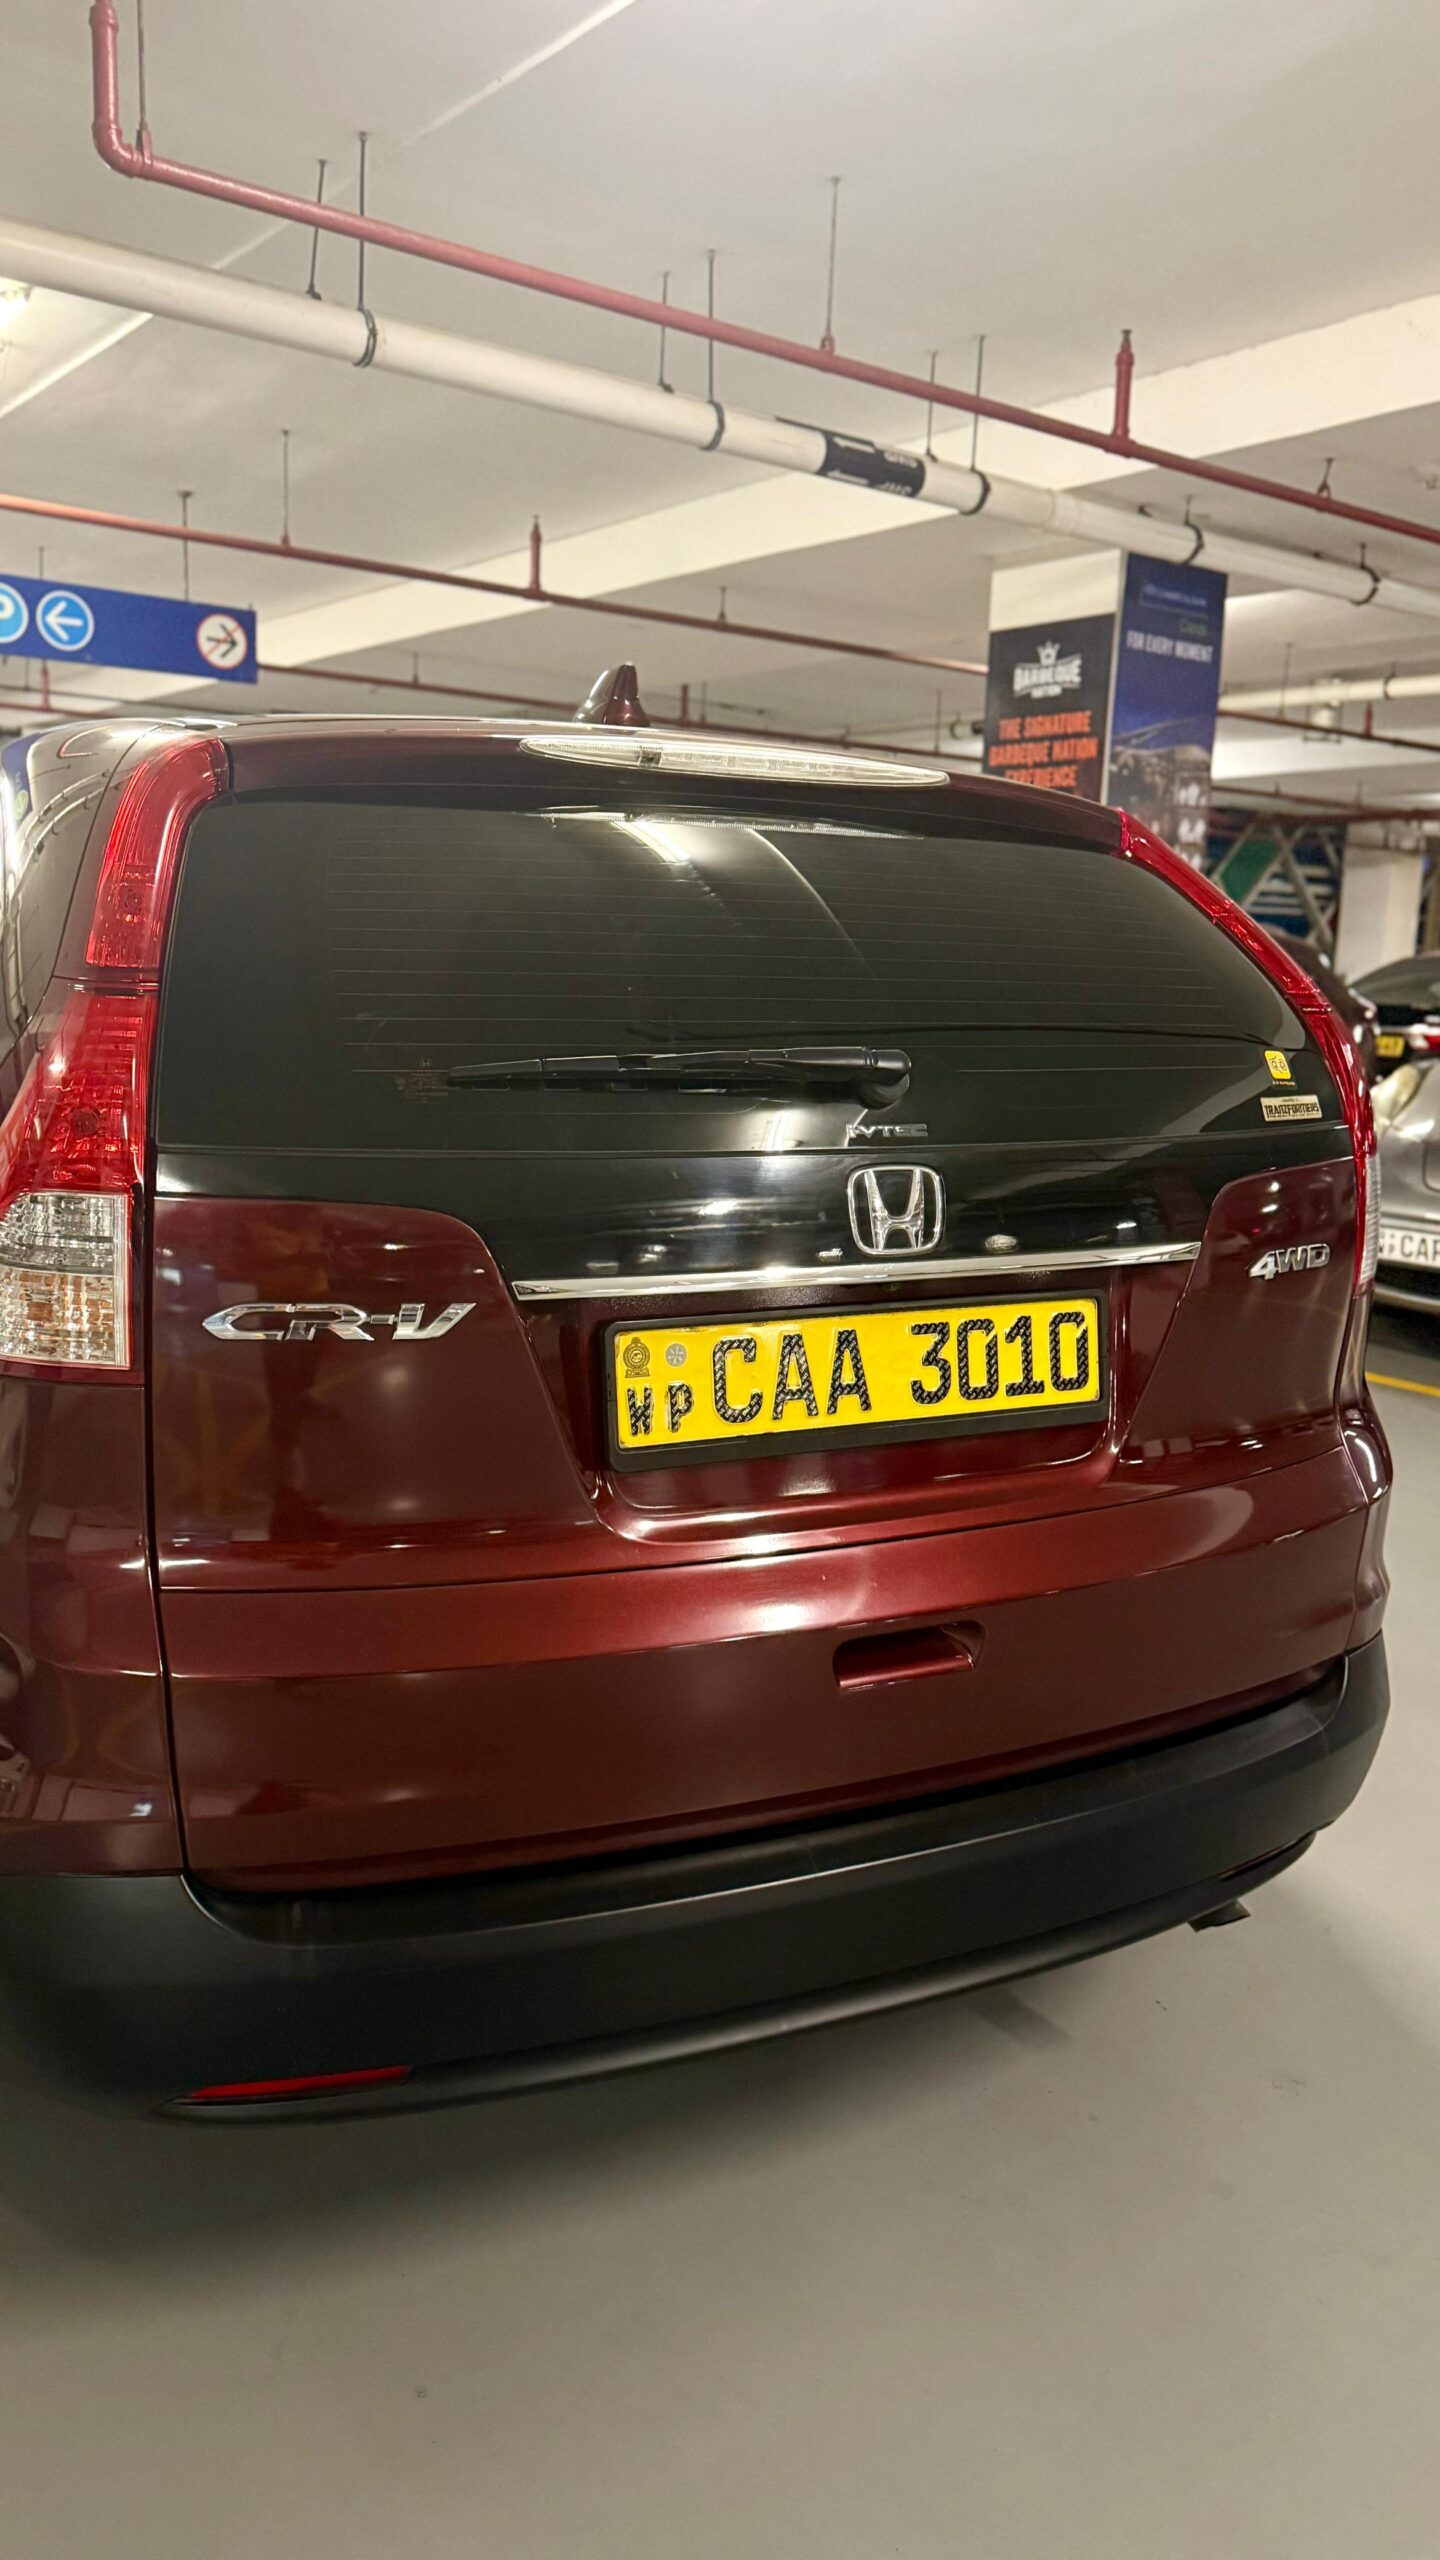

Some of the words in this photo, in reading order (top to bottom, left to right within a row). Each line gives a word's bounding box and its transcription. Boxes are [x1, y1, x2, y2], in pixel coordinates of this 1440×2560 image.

[1126, 630, 1144, 650] FOR
[1146, 634, 1173, 656] EVERY
[1174, 641, 1213, 663] MOMENT
[1013, 656, 1083, 692] BARBEQUE
[999, 717, 1021, 740] THE
[1023, 710, 1092, 738] SIGNATURE
[987, 741, 1050, 768] BARBEQUE
[1052, 737, 1098, 761] NATION
[1248, 1244, 1330, 1281] 4WD
[200, 1301, 476, 1341] CR-V
[710, 1329, 872, 1424] CAA
[909, 1311, 1090, 1405] 3010
